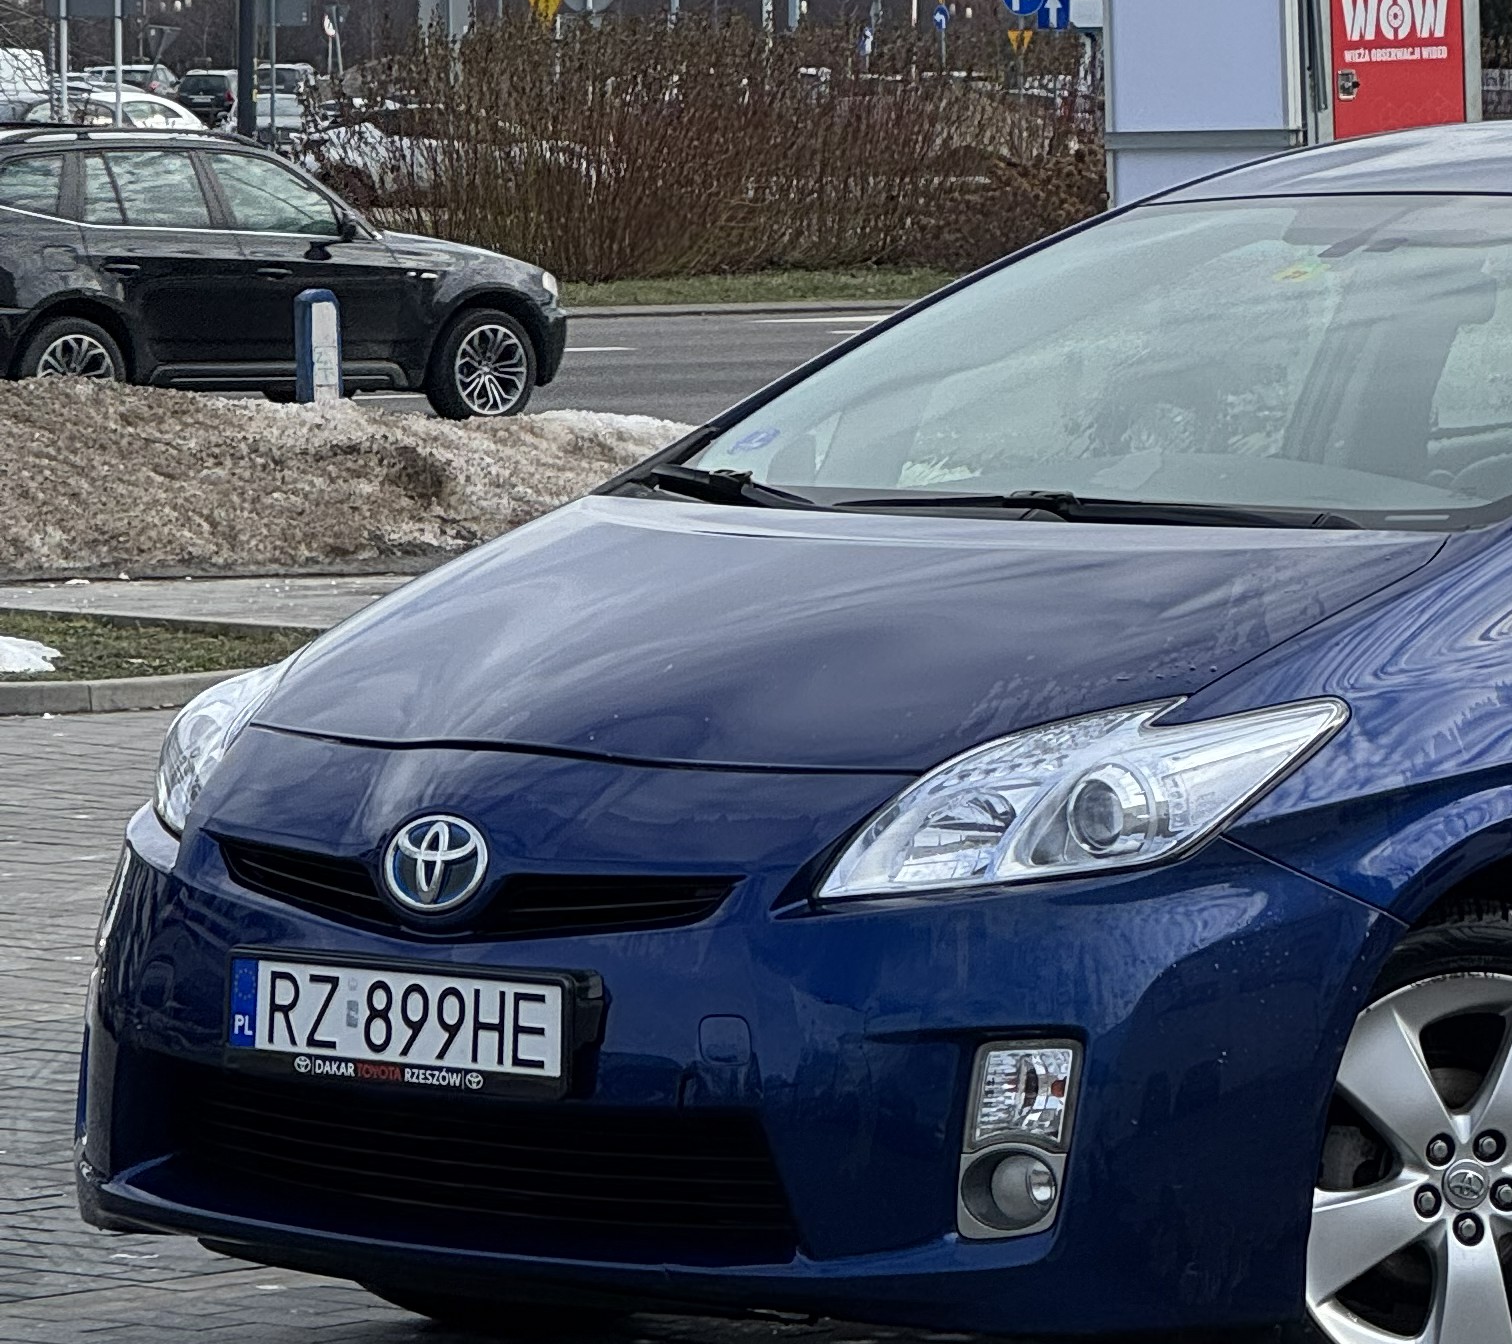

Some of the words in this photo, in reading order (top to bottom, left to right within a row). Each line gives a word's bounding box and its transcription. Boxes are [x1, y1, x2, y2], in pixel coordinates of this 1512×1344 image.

[233, 1014, 253, 1036] PL
[267, 970, 341, 1050] RZ
[363, 979, 547, 1069] 899HE
[314, 1059, 355, 1077] DAKAR
[356, 1062, 403, 1080] TOYOTA
[404, 1068, 462, 1087] RZESZÓW
